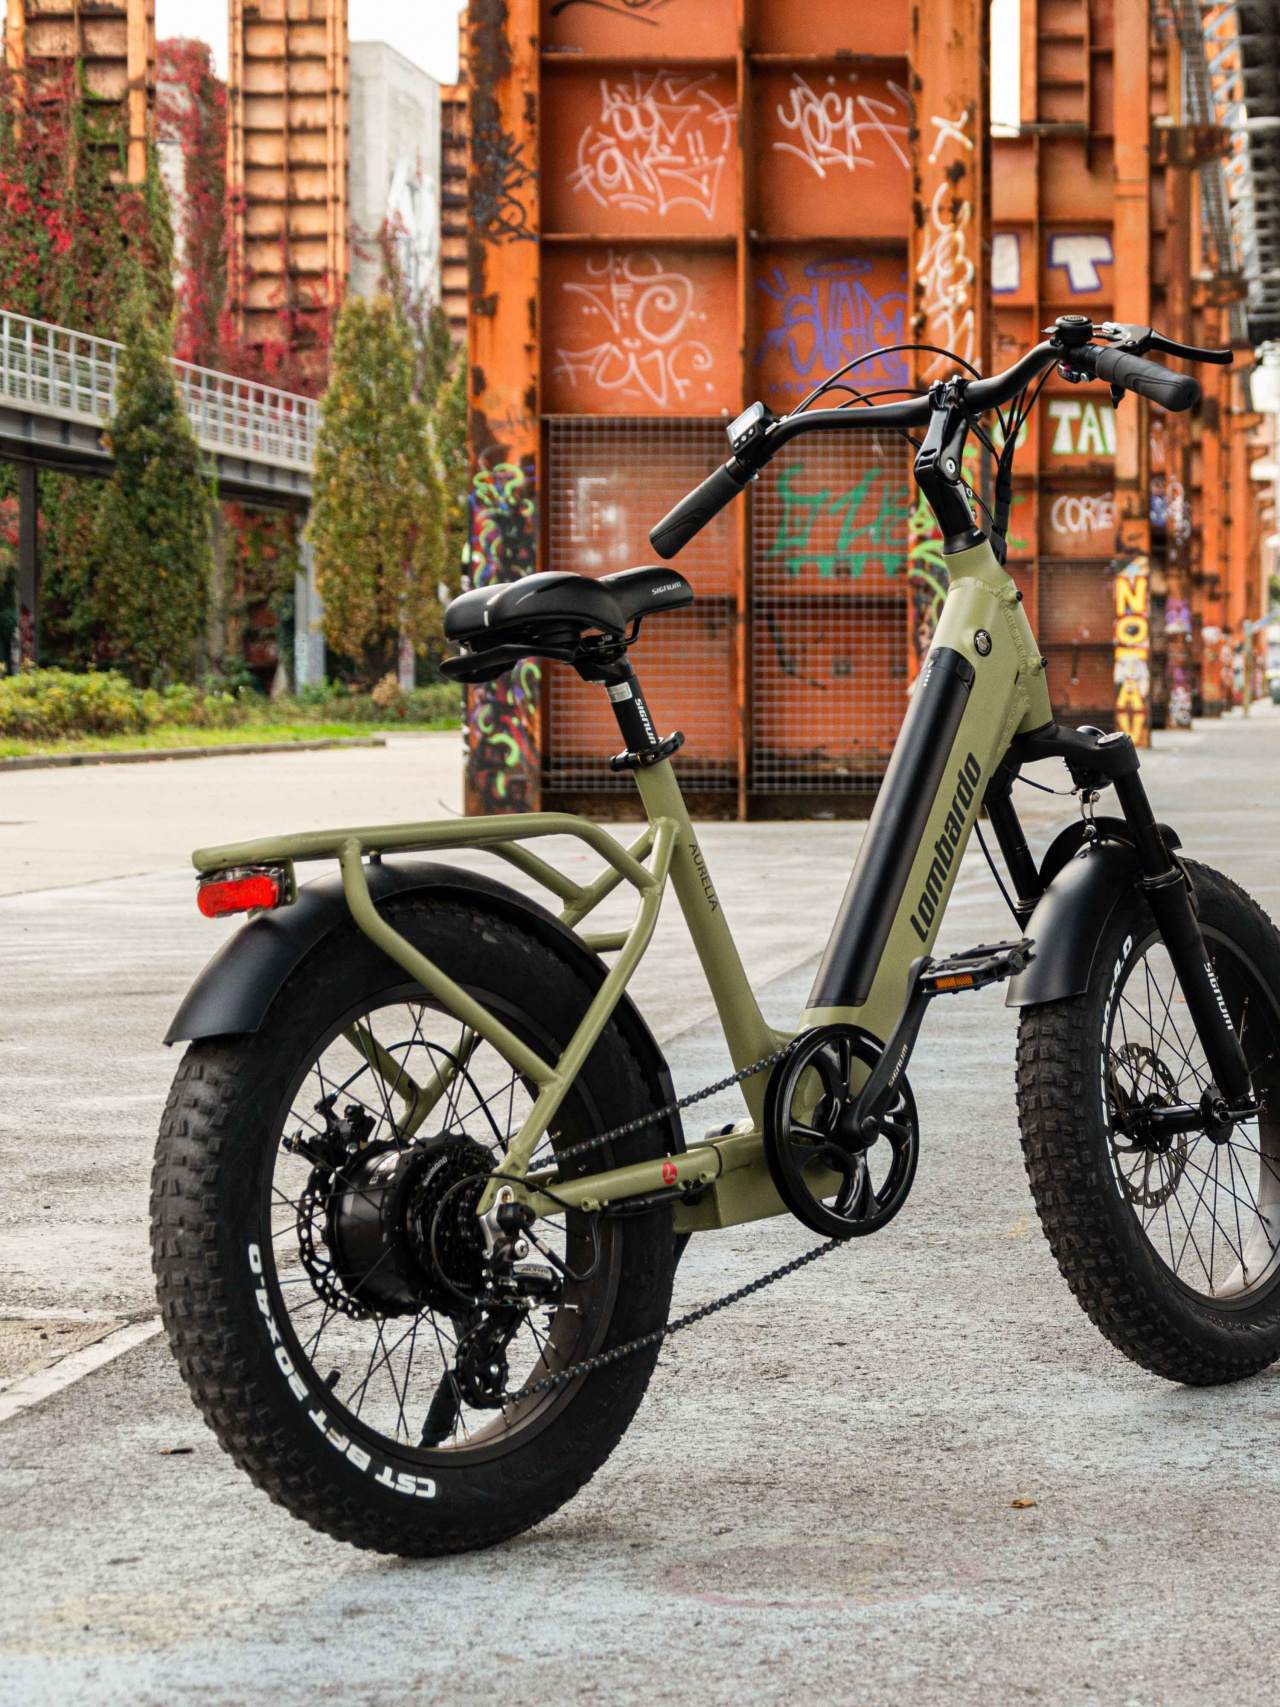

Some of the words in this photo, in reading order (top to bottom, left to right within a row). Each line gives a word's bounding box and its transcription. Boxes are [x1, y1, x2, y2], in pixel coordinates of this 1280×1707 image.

[651, 581, 682, 595] SIGNUM
[688, 843, 718, 912] AURELIA
[1203, 961, 1234, 1030] SIGNUM
[888, 1043, 908, 1088] SIGNUM
[308, 1409, 372, 1472] BFT
[374, 1465, 437, 1498] CST
